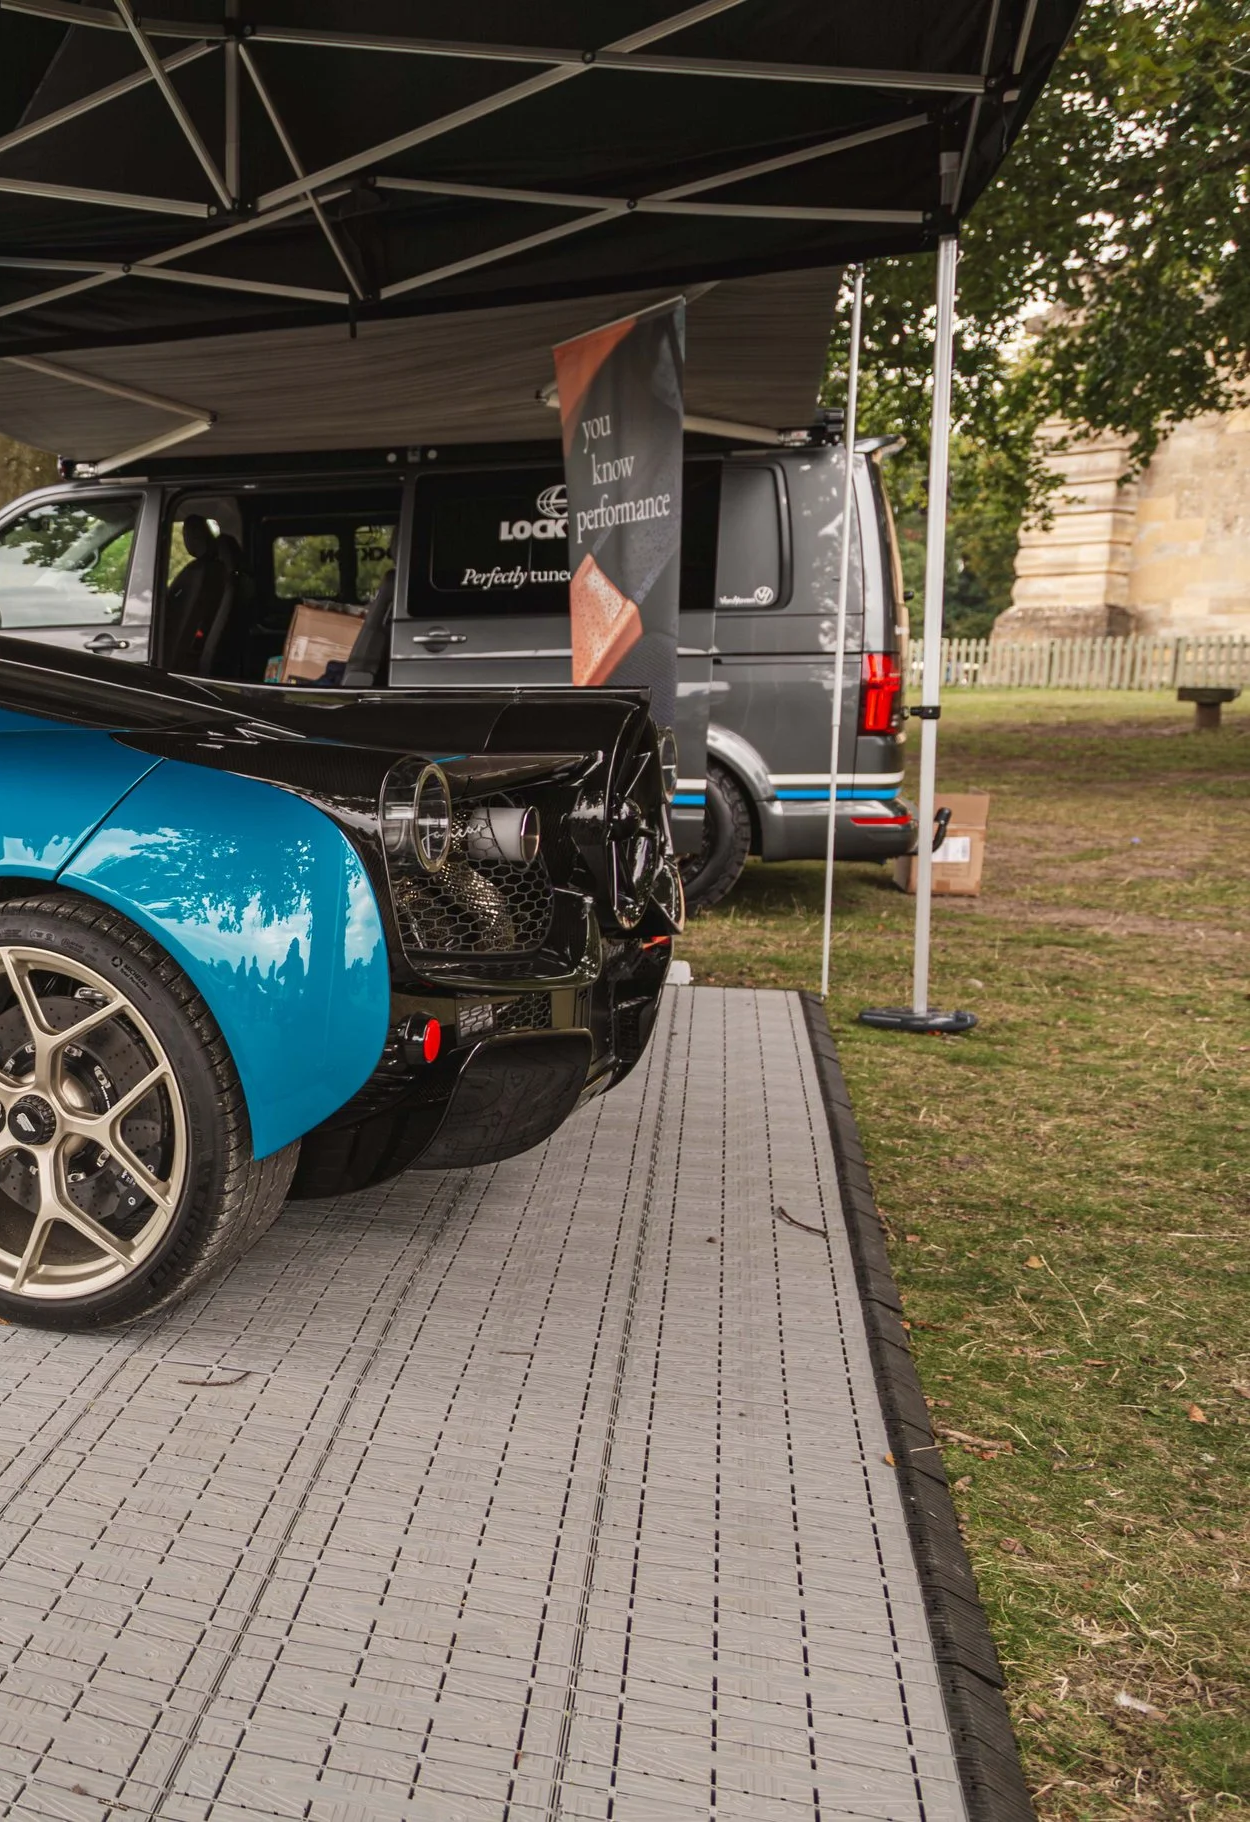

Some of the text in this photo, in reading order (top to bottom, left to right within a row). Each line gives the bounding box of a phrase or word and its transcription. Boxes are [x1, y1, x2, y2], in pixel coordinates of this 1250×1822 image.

[581, 415, 611, 454] you
[591, 453, 635, 485] know
[499, 518, 569, 541] LOCK
[576, 493, 670, 544] performance
[461, 566, 528, 590] Perfectly
[123, 964, 149, 988] MICHELIN
